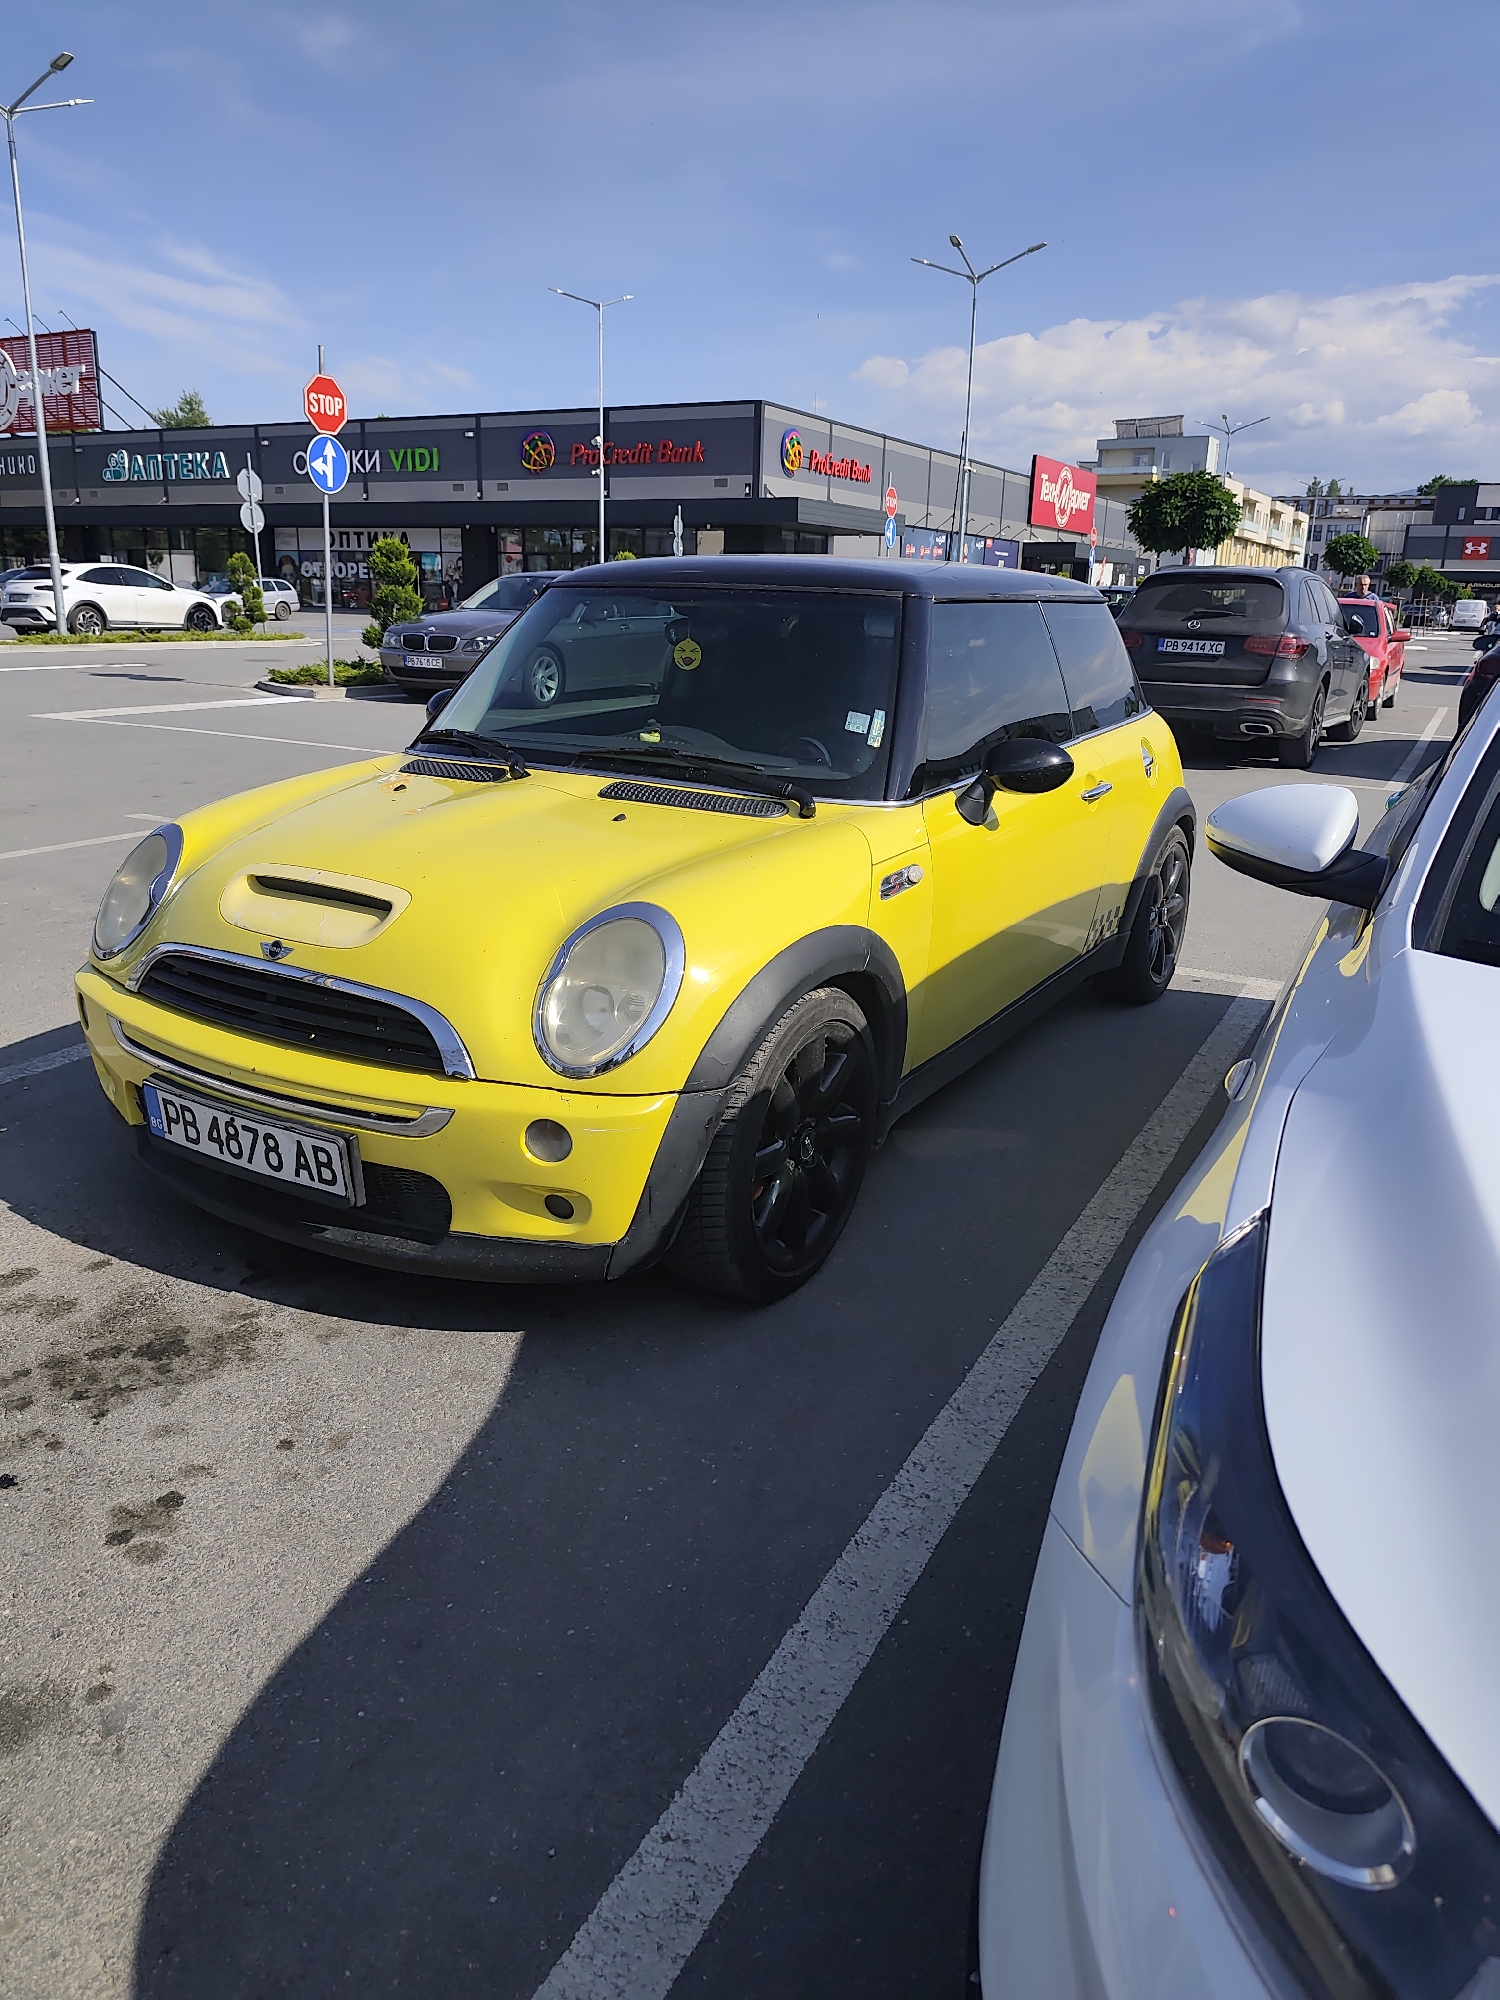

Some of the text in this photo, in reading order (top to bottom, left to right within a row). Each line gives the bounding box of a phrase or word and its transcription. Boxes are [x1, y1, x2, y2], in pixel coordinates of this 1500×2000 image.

[308, 392, 343, 417] STOP
[130, 451, 230, 481] АПТЕКА
[292, 447, 439, 475] ОКИ VIDI
[570, 439, 706, 466] ProCredit Bank
[809, 449, 873, 484] ProCredit Bank
[1164, 639, 1223, 654] PB 9414 XC
[150, 1116, 163, 1131] BG
[161, 1096, 338, 1187] PB 4878 AB
